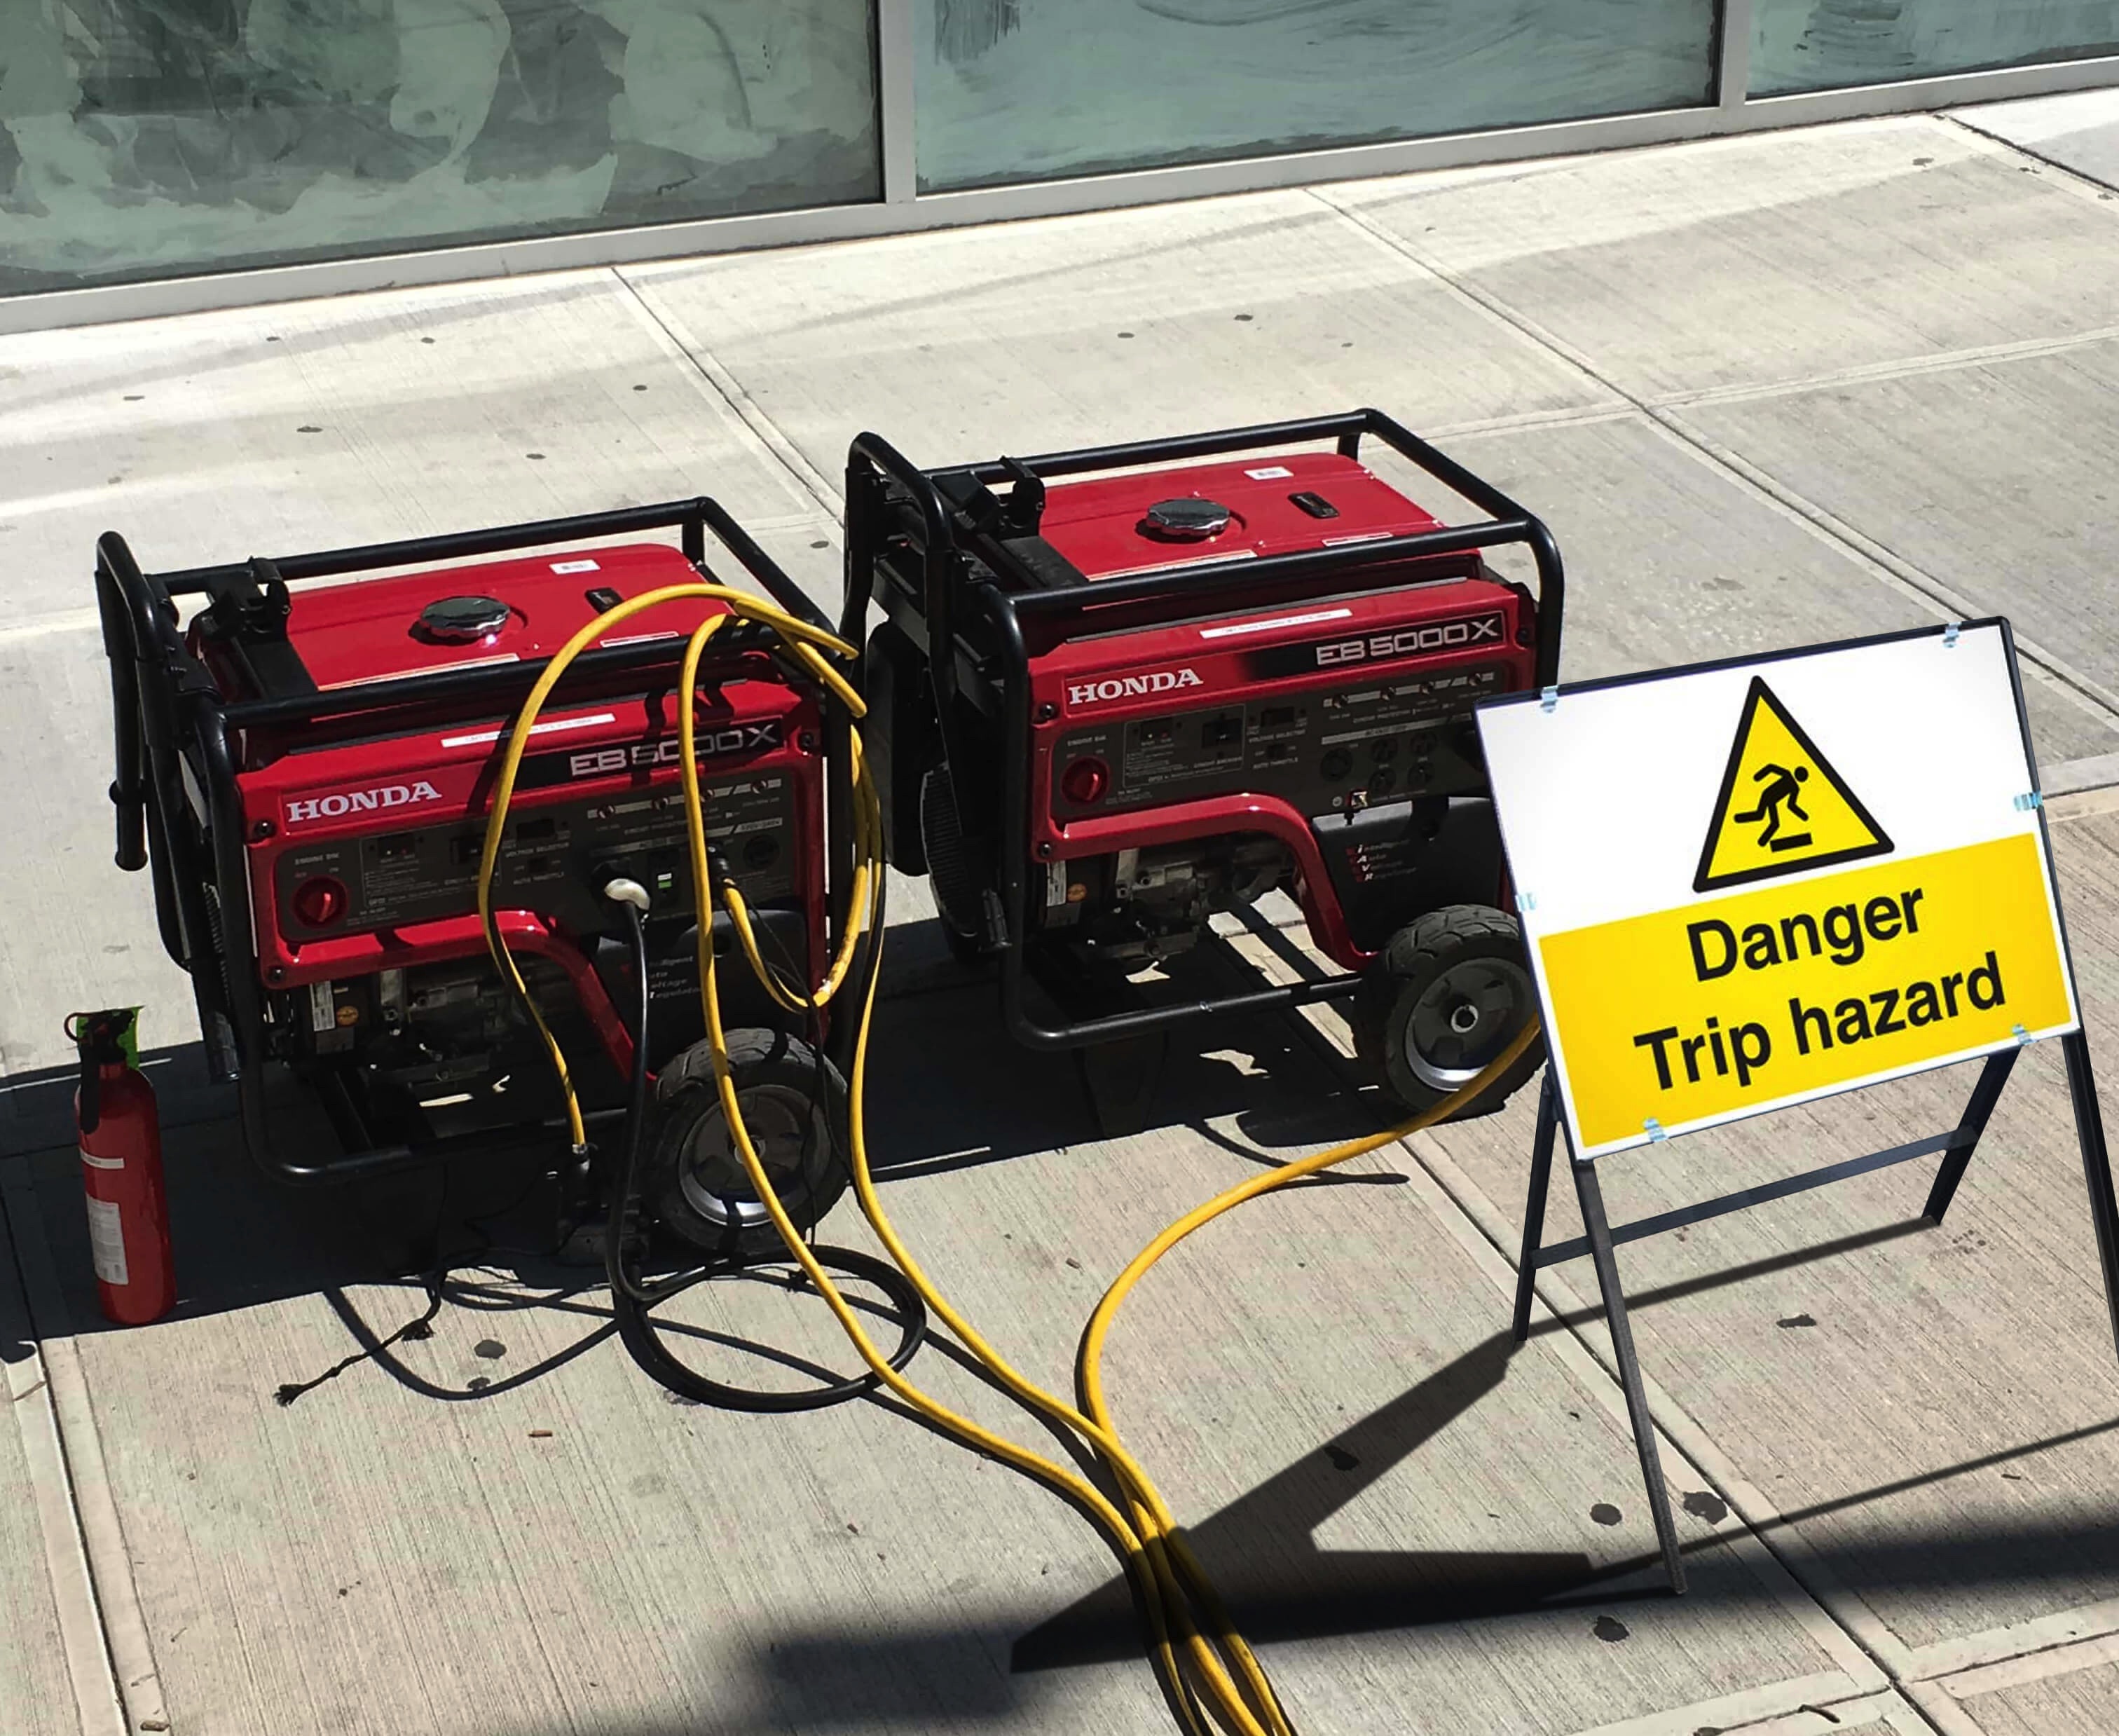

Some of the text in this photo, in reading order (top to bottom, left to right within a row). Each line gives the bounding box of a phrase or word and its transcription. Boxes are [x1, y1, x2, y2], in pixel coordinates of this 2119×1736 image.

[1068, 668, 1204, 704] HONDA
[287, 781, 442, 822] HONDA
[1686, 887, 1923, 982] Danger
[1633, 950, 2005, 1091] Trip hazard
